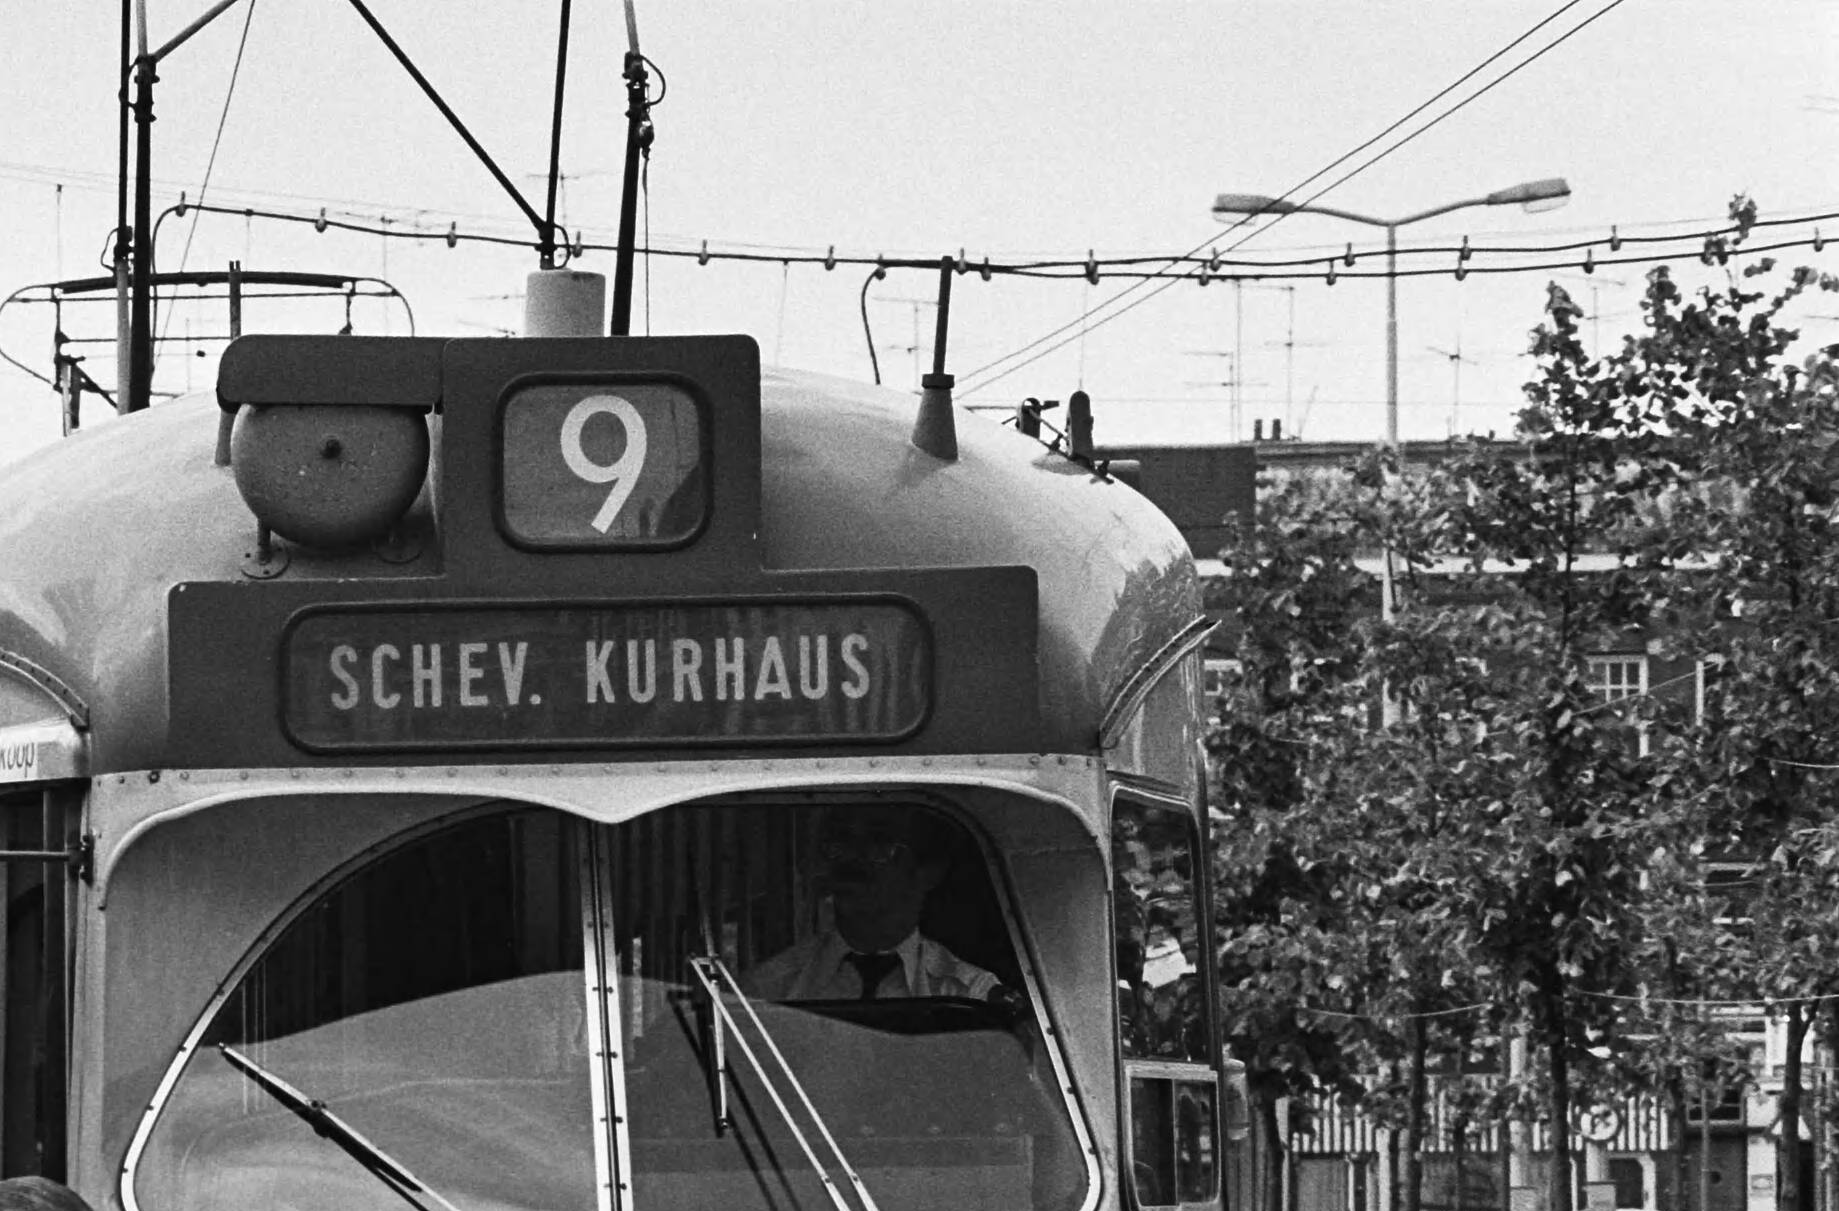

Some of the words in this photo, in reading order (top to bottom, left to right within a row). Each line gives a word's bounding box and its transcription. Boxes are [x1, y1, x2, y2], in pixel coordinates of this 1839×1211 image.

[561, 395, 647, 534] 9
[330, 641, 542, 710] SCHEV.
[586, 633, 871, 704] KURHAUS
